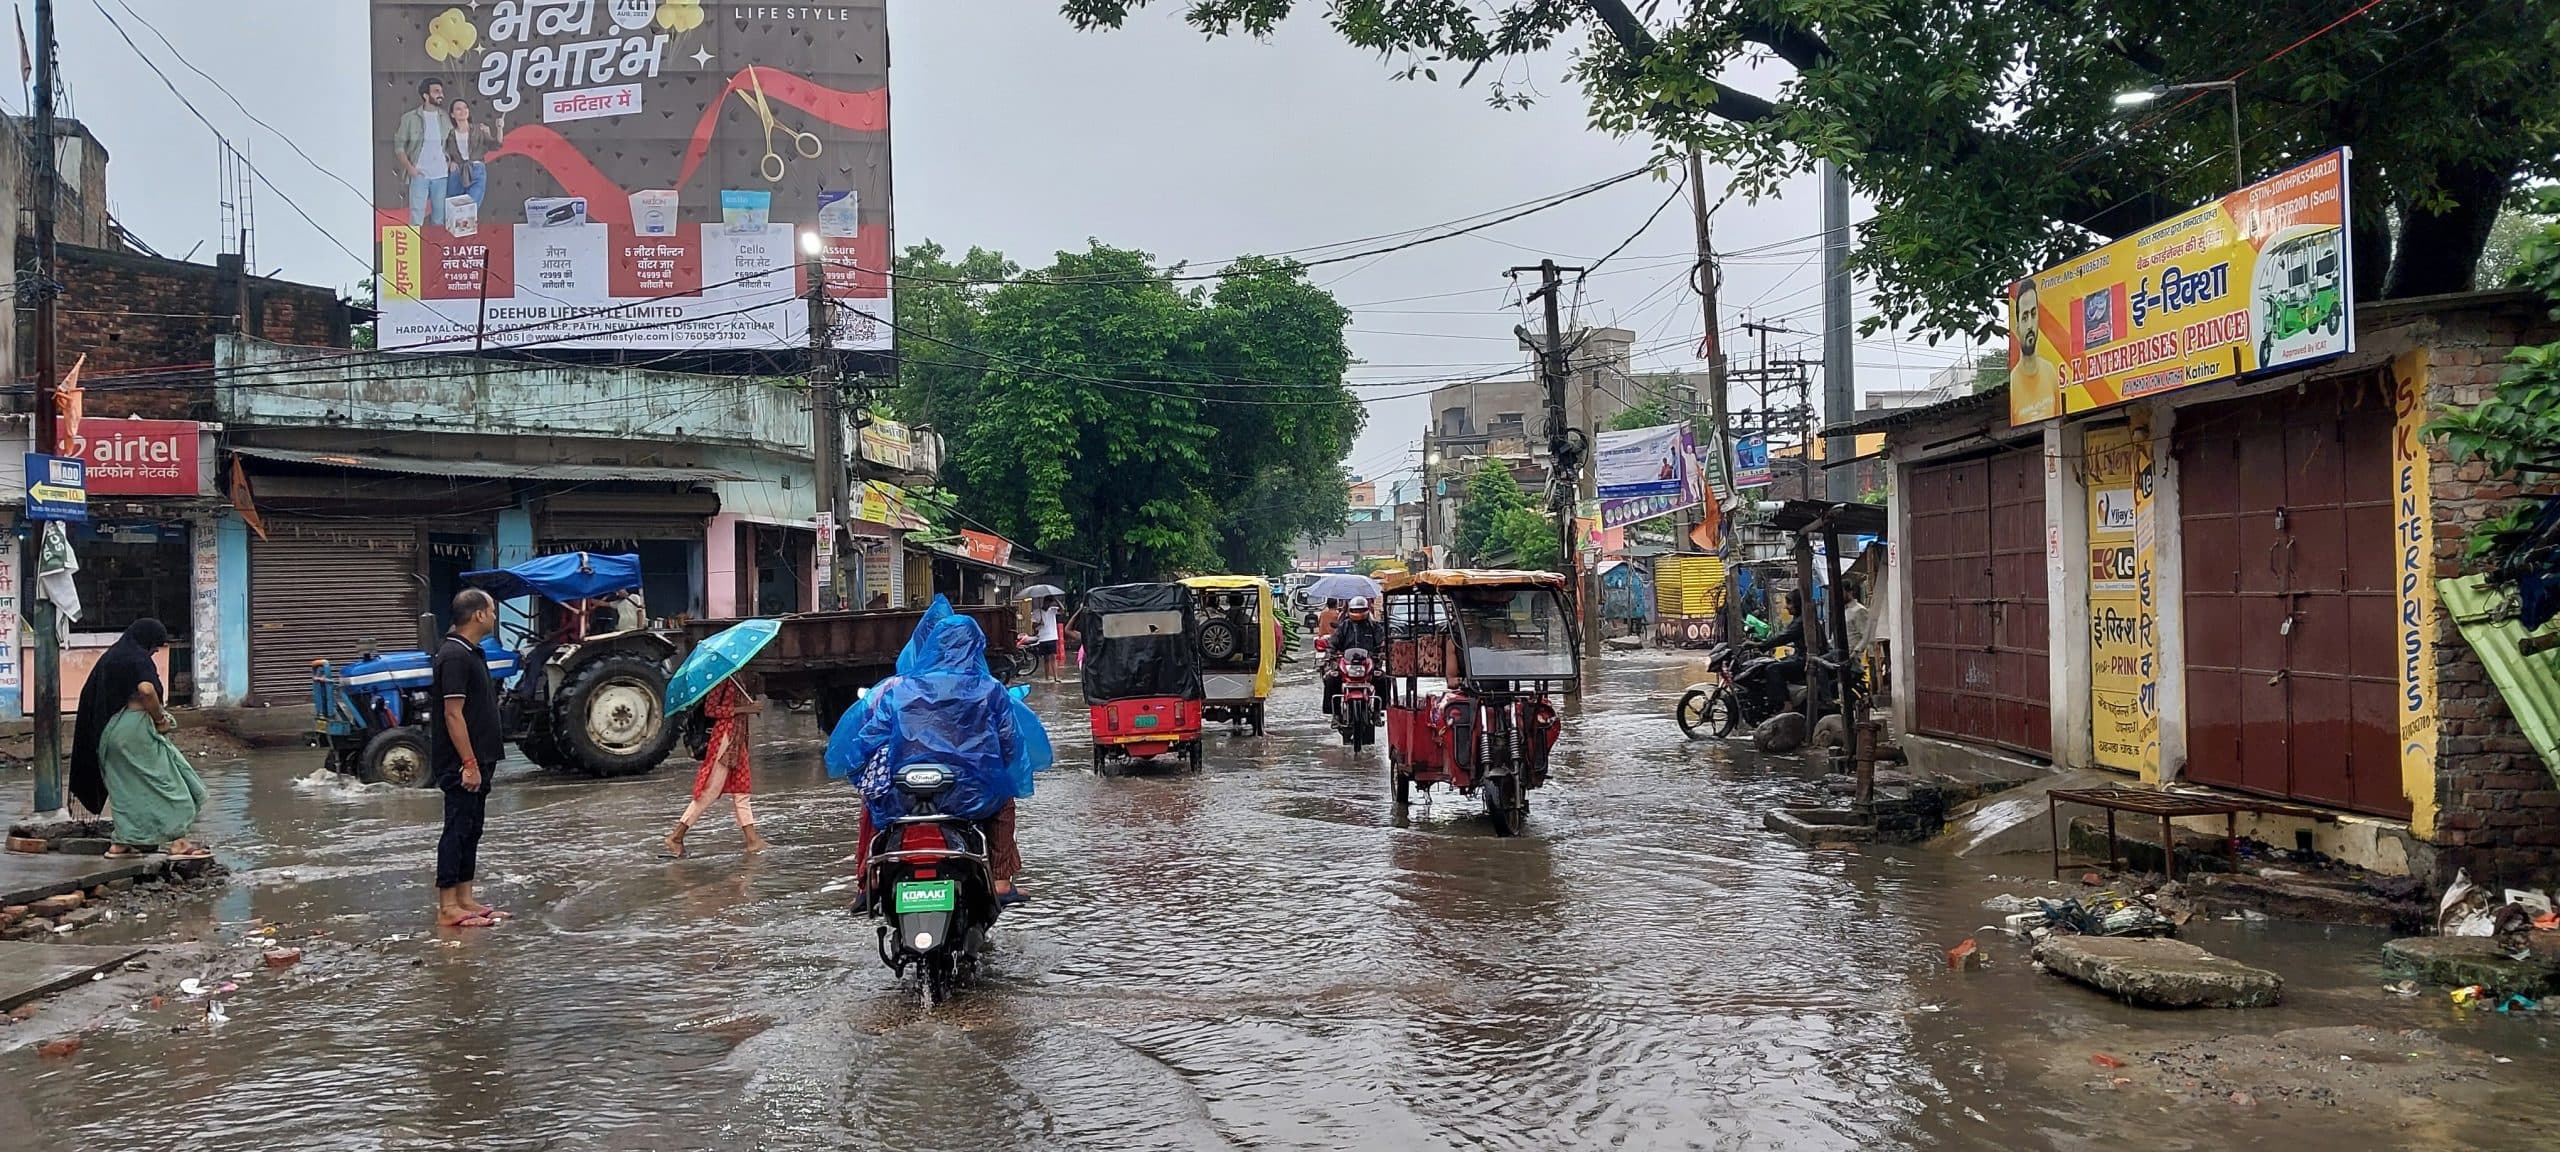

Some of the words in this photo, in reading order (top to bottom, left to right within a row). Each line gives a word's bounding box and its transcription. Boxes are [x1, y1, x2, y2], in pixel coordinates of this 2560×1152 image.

[488, 0, 594, 42] भव्य
[735, 7, 849, 21] LIFESTYLE
[478, 24, 670, 112] शुभारंभ
[553, 95, 613, 113] कटिहार
[616, 89, 632, 107] में
[2311, 184, 2339, 210] (Sonu)
[443, 246, 450, 256] 3
[453, 245, 487, 256] LAYER
[740, 245, 765, 254] Cello
[823, 245, 855, 254] Assure
[2185, 236, 2197, 251] की
[625, 247, 631, 257] 5
[634, 245, 655, 257] लीटर
[637, 257, 658, 269] वॉटर
[659, 259, 674, 269] जार
[735, 255, 755, 267] डिनर
[756, 255, 770, 267] सेट
[2130, 263, 2230, 328] ई-रिक्शा
[489, 307, 547, 319] DEEHUB
[551, 307, 622, 319] LIFESTYLE
[625, 306, 683, 318] LIMITED
[395, 325, 450, 334] HARDAYAL
[605, 322, 627, 331] NEW
[731, 322, 775, 330] KATIHAR
[425, 335, 442, 344] PIN
[2059, 364, 2069, 388] S.
[2072, 358, 2084, 384] K.
[2087, 330, 2178, 380] ENTERPRISES
[2183, 310, 2250, 360] (PRINCE)
[2185, 361, 2220, 381] Katihar
[94, 432, 180, 462] airtel
[138, 463, 180, 479] नेटवर्क
[2111, 508, 2134, 524] Vijay's
[97, 523, 116, 534] Jio
[2398, 465, 2424, 712] ENTERPRISES
[902, 889, 947, 902] KOMAKI
